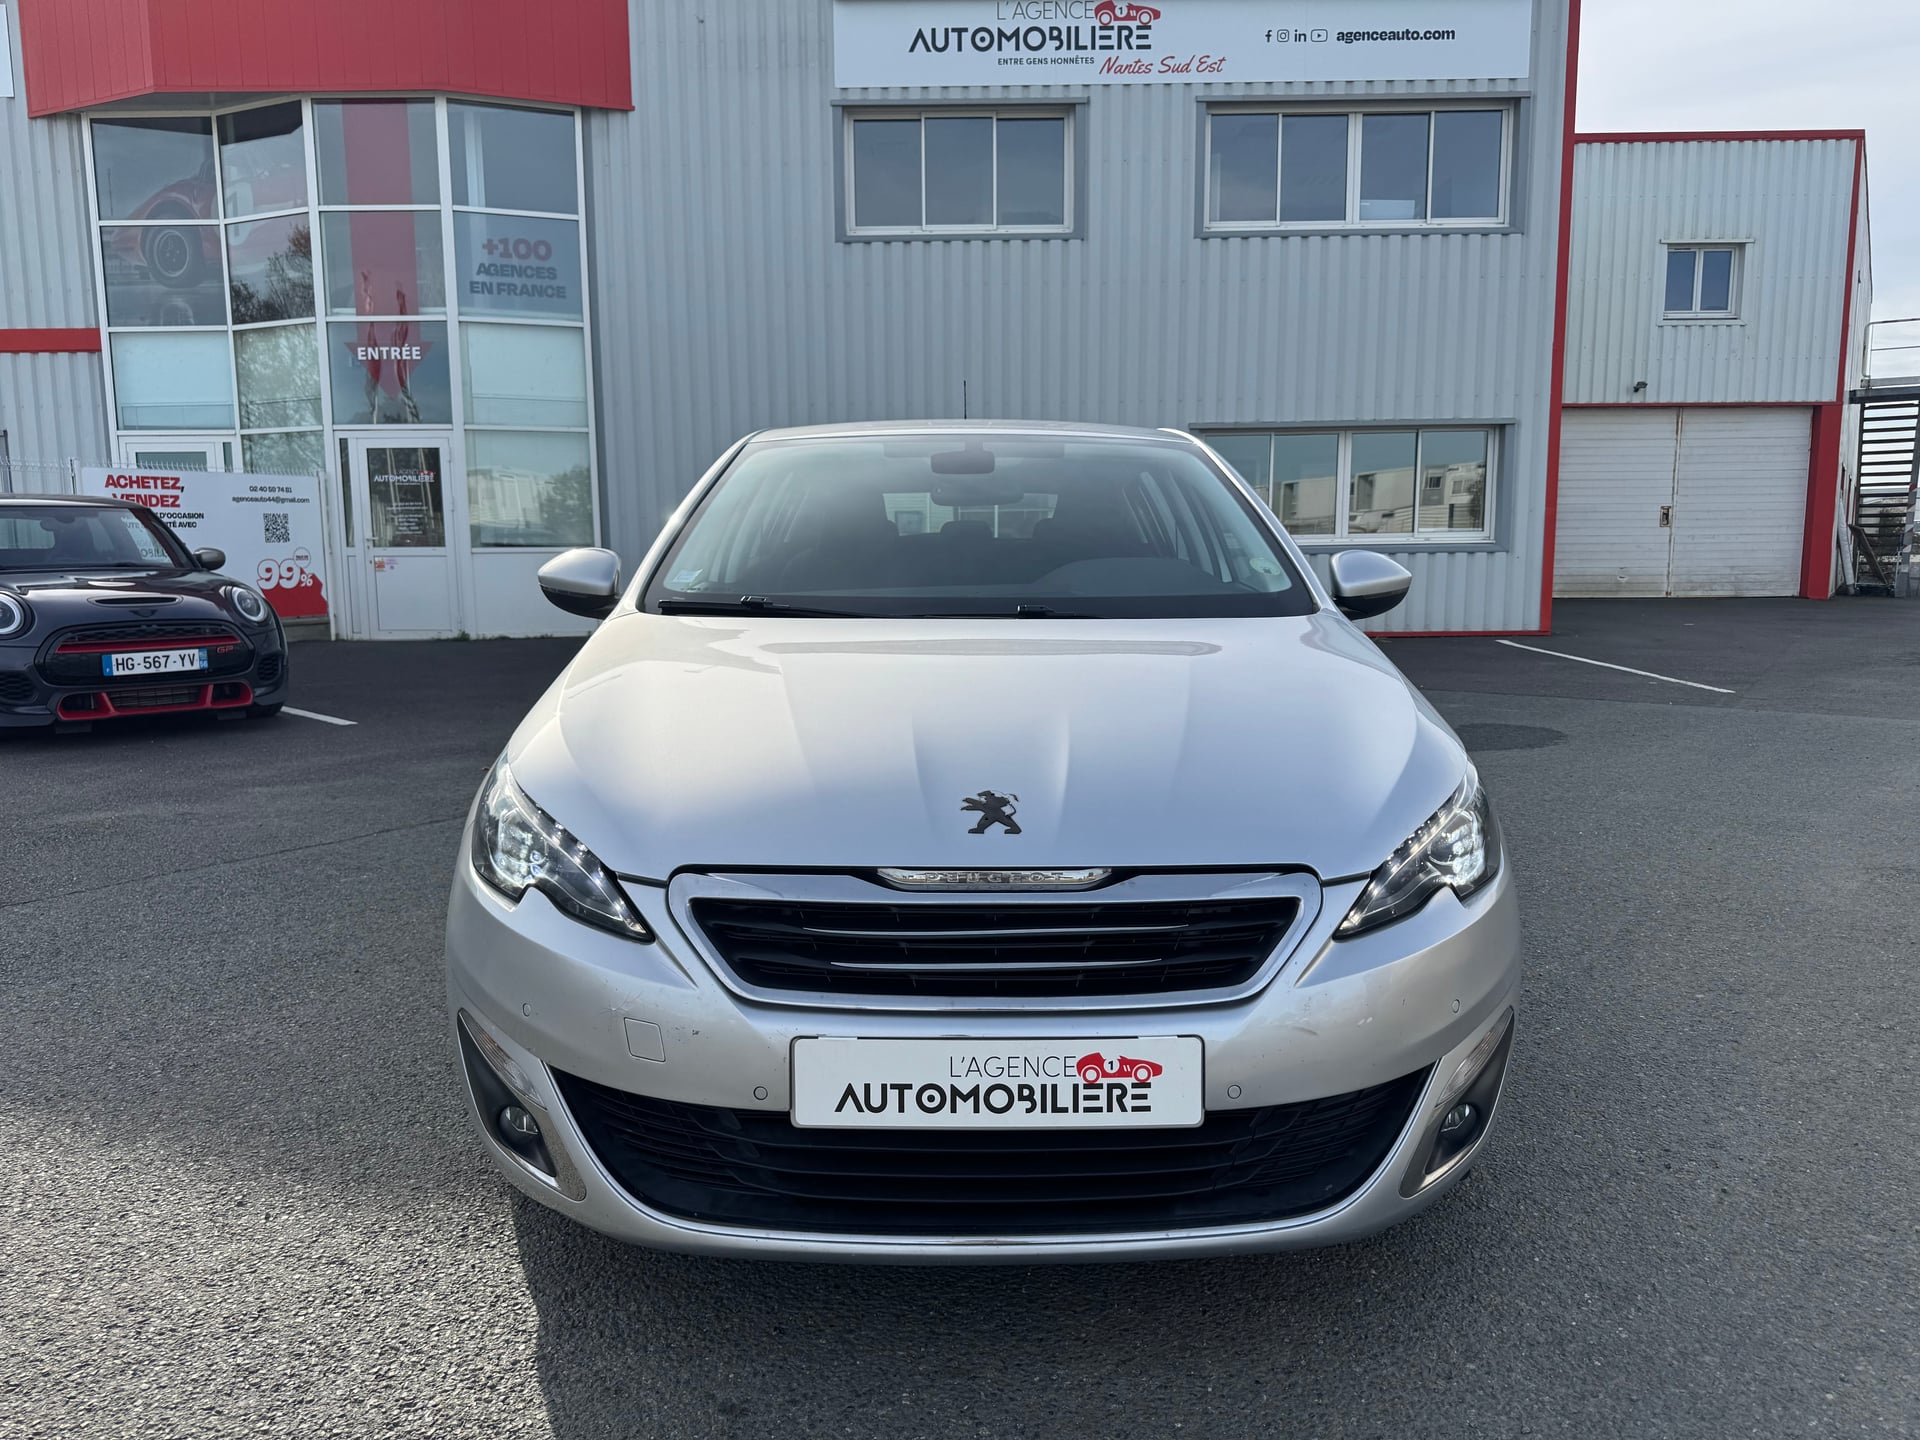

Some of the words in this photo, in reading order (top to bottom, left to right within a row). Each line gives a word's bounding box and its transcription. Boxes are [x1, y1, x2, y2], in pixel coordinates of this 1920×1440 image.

[997, 1, 1094, 20] L'AGENCE
[1336, 29, 1456, 43] agenceauto.com
[998, 58, 1024, 66] ENTRE
[1050, 55, 1095, 65] HONNÊTES
[1099, 56, 1153, 75] Nantes
[1158, 54, 1194, 74] Sud
[1196, 55, 1226, 73] Est
[482, 237, 552, 261] +100
[476, 263, 557, 280] AGENCES
[469, 281, 494, 295] EN
[496, 283, 567, 299] FRANCE
[357, 344, 421, 361] ENTRÉE
[105, 474, 184, 493] ACHETEZ,
[925, 871, 1064, 883] PEUGEOT
[950, 1055, 1077, 1078] L'AGENCE
